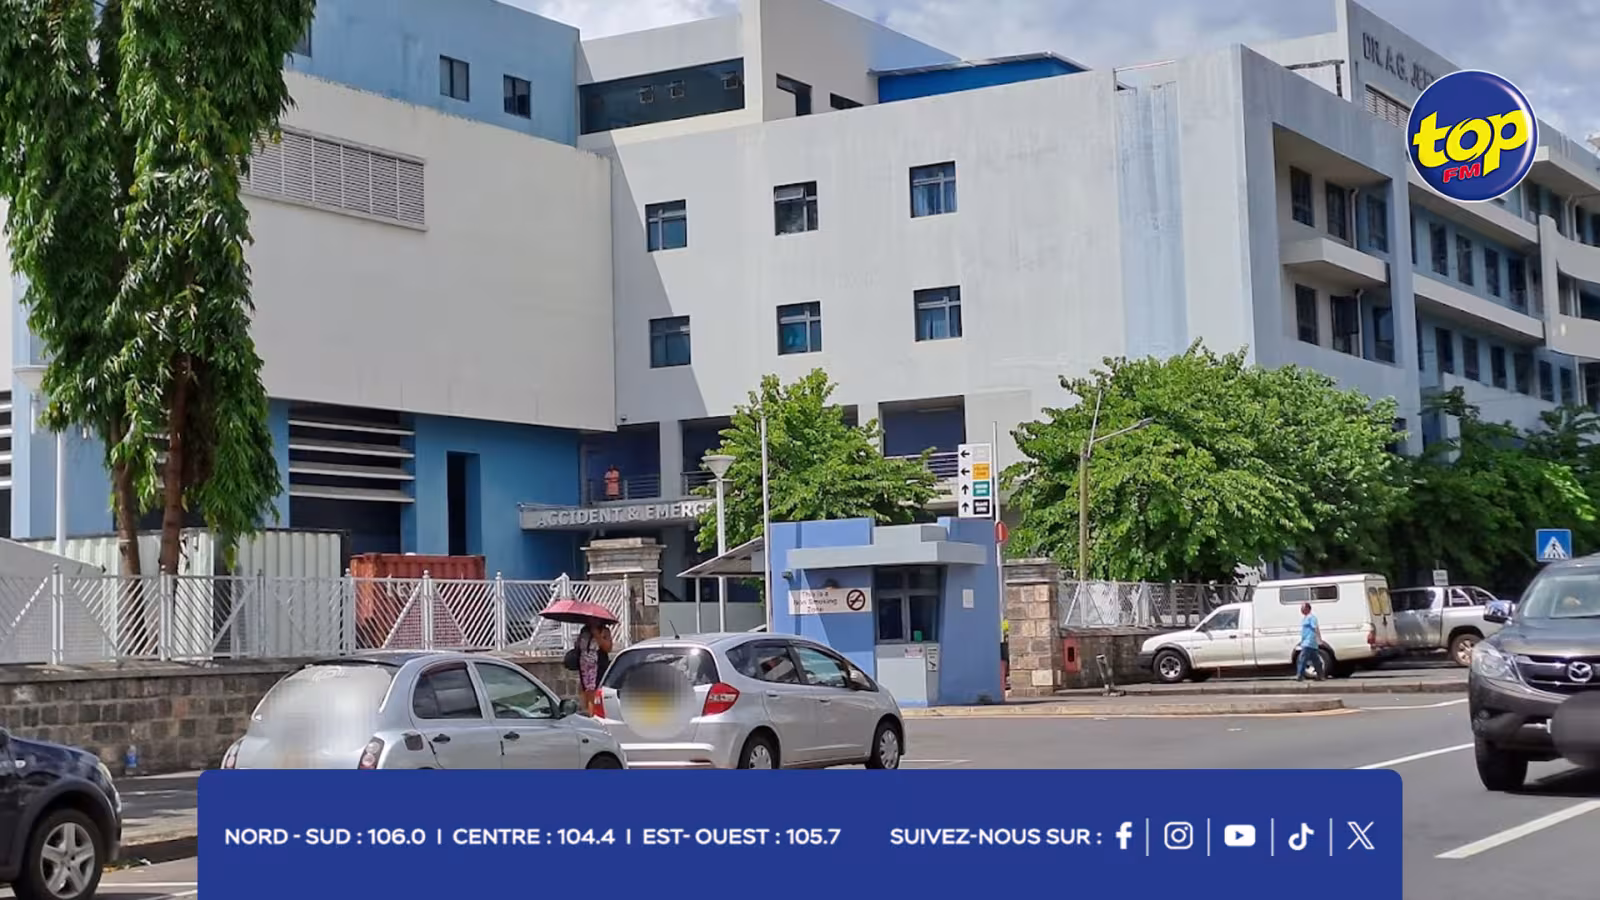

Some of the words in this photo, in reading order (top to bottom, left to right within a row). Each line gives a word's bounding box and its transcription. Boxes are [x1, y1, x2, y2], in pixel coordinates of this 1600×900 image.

[536, 507, 624, 528] ACCIDENT
[628, 506, 640, 521] &
[808, 598, 838, 606] Smoking
